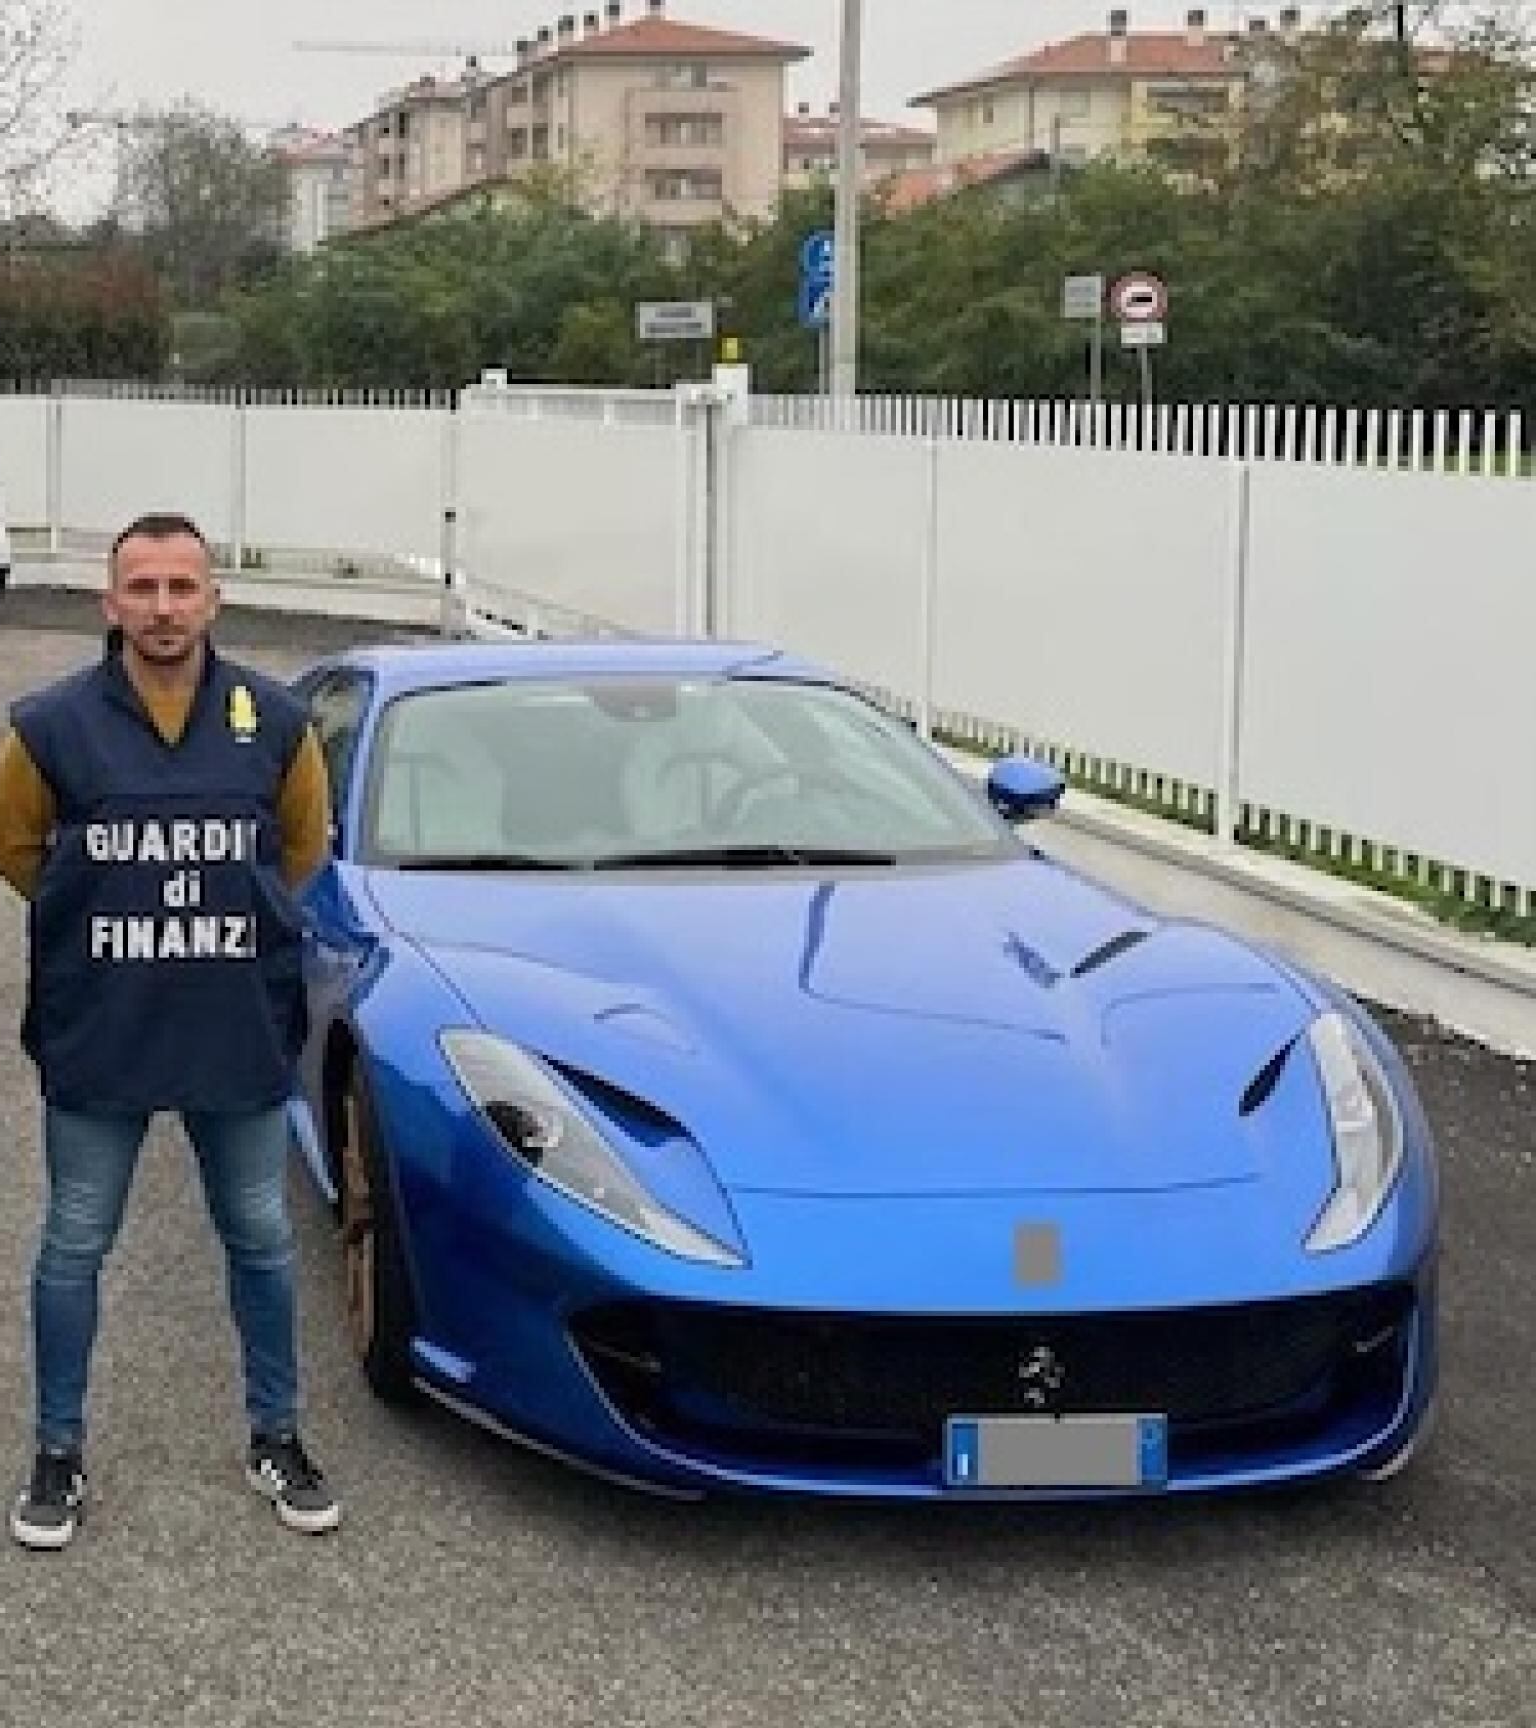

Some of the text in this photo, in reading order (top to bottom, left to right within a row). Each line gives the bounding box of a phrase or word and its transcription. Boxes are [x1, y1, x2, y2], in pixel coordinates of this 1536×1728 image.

[86, 819, 257, 861] GUARDI
[164, 869, 201, 907] di
[91, 916, 257, 958] FINANZ
